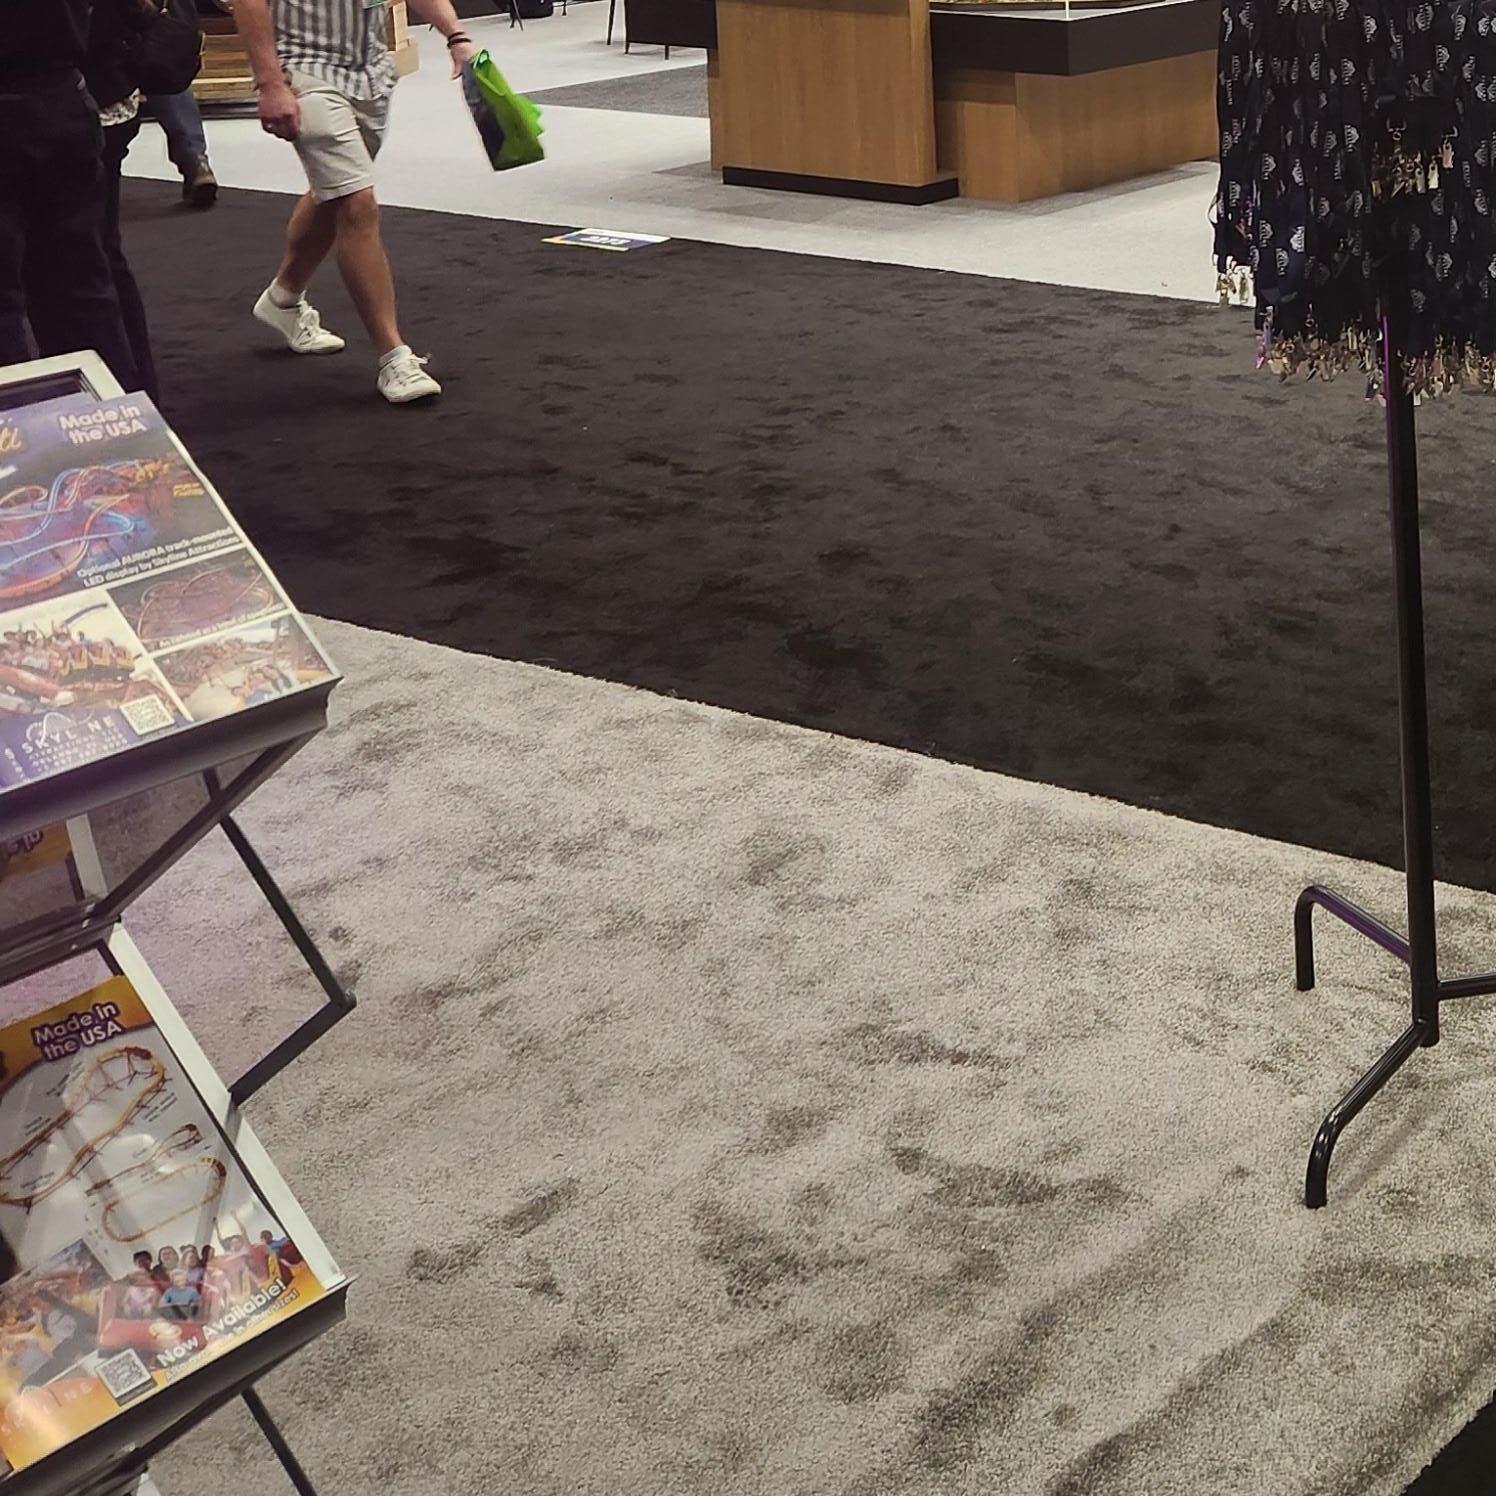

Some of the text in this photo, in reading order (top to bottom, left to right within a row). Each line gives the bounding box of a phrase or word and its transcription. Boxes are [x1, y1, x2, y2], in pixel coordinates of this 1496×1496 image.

[58, 405, 141, 430] Made in
[68, 419, 147, 444] the USA
[84, 574, 105, 587] LED
[22, 715, 115, 753] SKYLNE
[35, 1004, 117, 1044] Made in
[44, 1020, 122, 1060] the USA
[156, 1335, 199, 1367] Now
[202, 1278, 287, 1340] Available!
